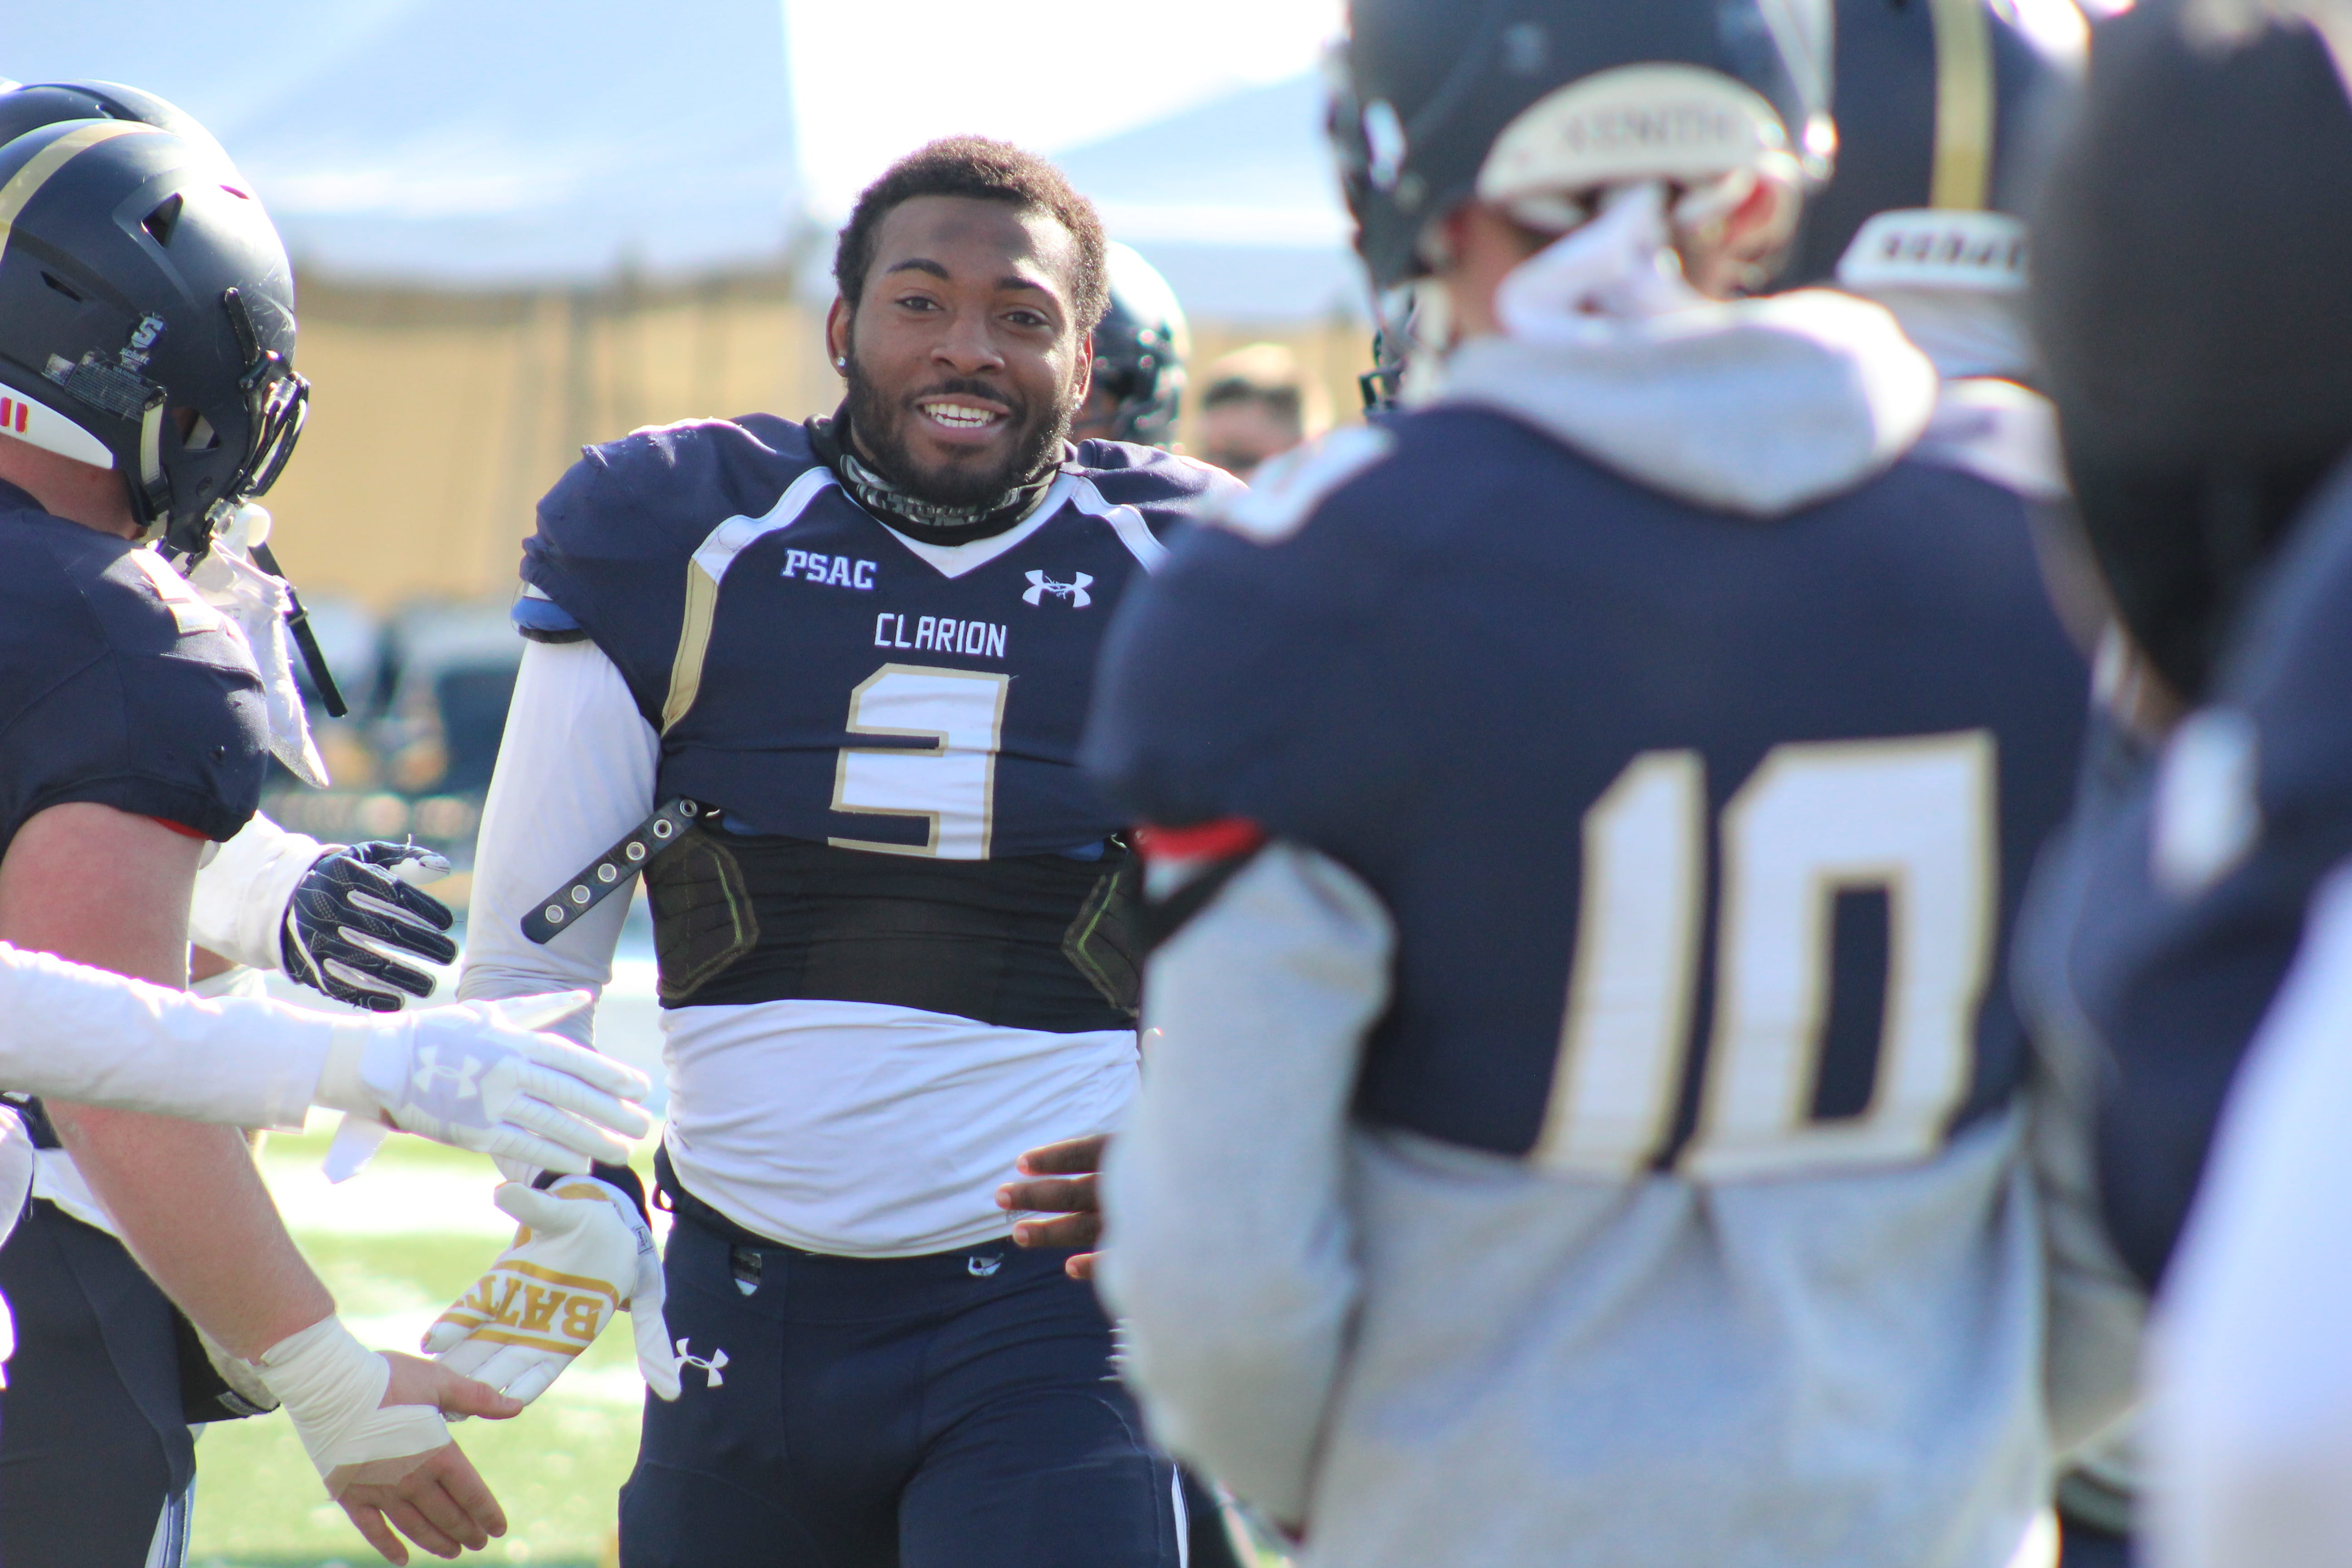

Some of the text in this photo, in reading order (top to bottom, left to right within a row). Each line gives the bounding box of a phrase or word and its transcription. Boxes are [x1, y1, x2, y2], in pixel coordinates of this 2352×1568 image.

[782, 548, 877, 589] PSAC
[875, 612, 1006, 657] CLARION
[1525, 729, 1999, 1175] 10
[453, 1275, 603, 1341] BATT
